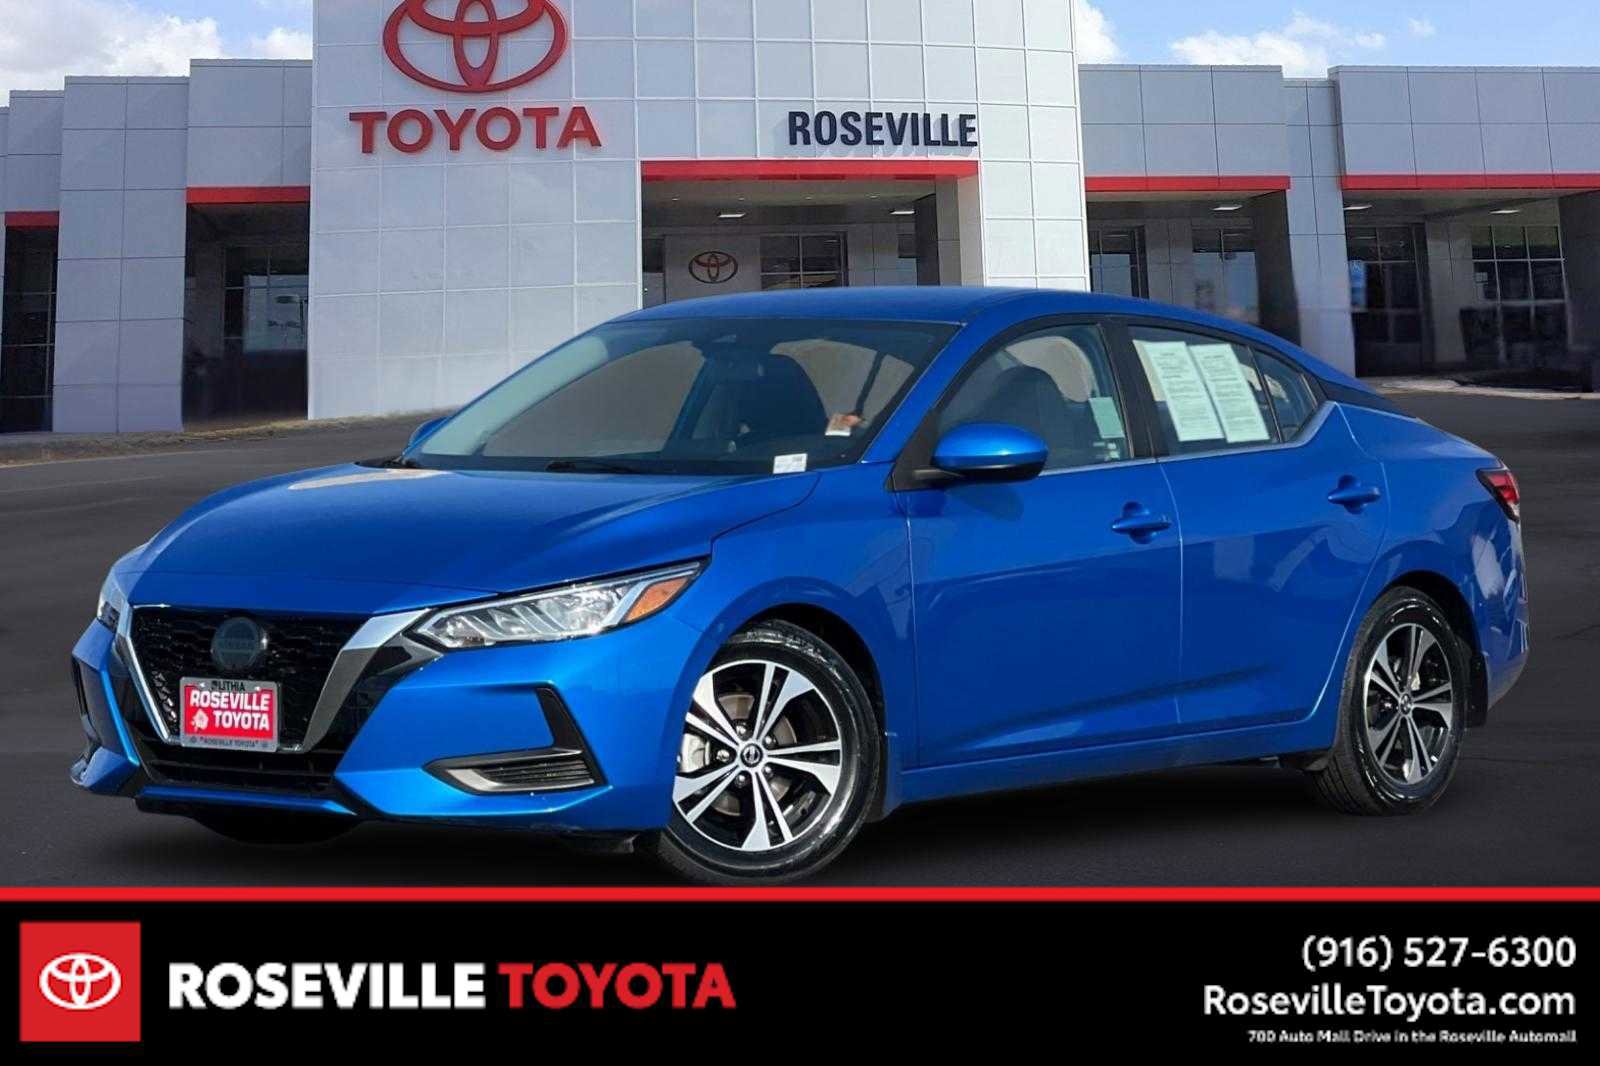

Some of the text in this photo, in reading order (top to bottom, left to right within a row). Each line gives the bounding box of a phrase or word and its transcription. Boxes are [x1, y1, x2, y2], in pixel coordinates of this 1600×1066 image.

[349, 106, 602, 154] TOYOTA
[788, 111, 978, 147] ROSEVILLE
[189, 689, 270, 711] ROSEVILLE
[212, 710, 270, 731] TOYOTA
